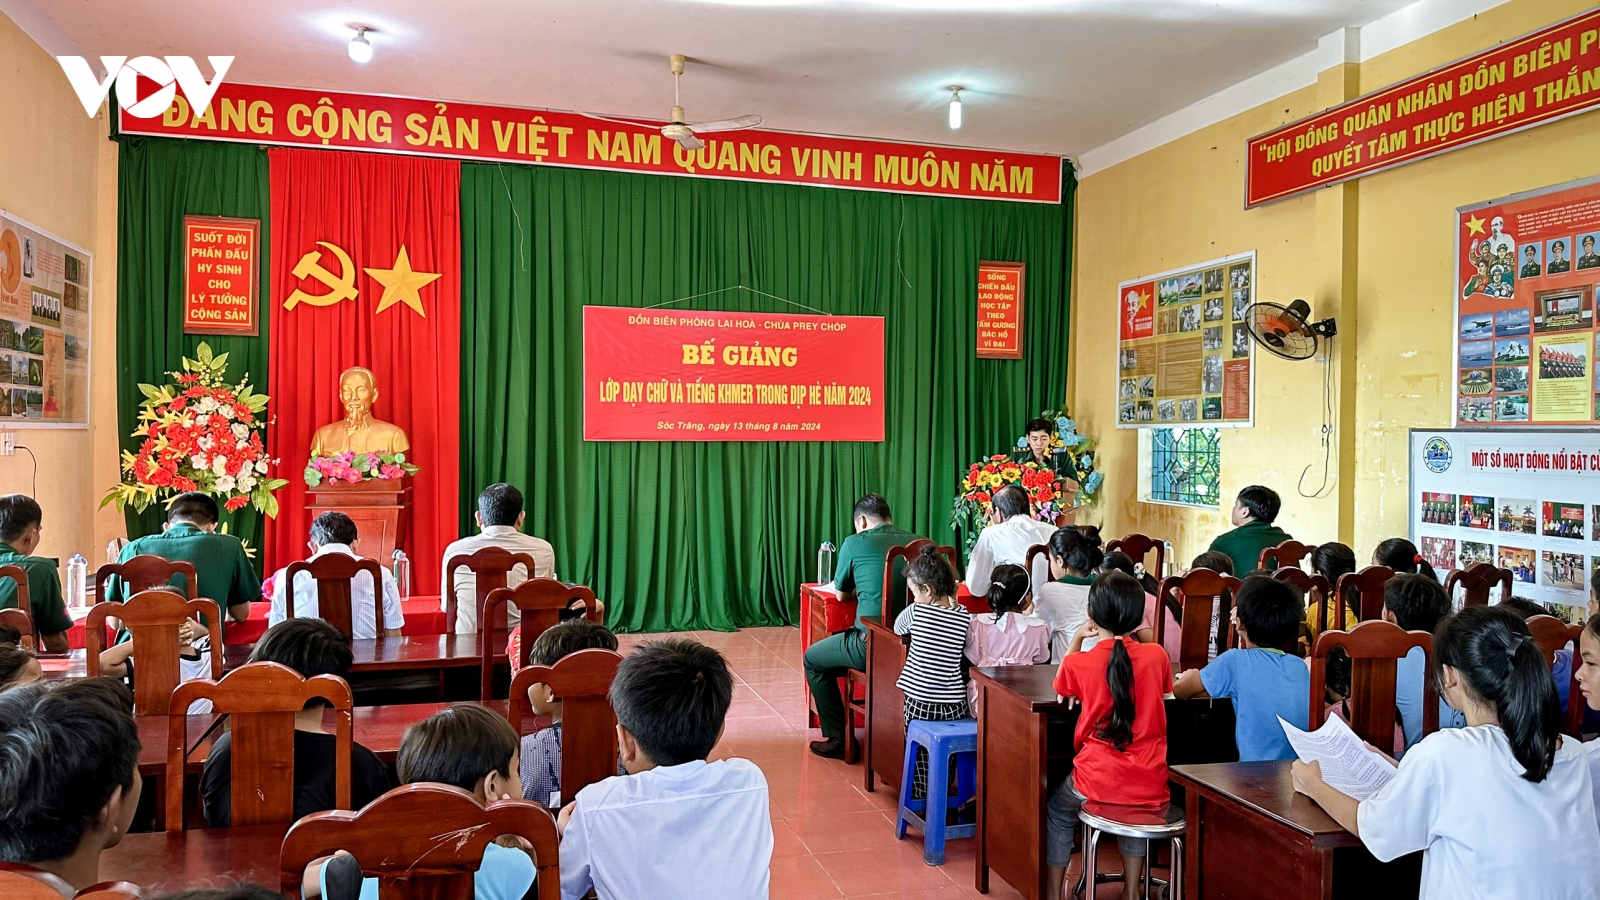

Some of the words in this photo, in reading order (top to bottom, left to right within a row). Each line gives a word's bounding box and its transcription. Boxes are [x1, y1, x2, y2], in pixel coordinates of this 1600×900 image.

[1295, 124, 1338, 153] ĐỒNG
[1343, 103, 1391, 136] QUÂN
[1397, 83, 1452, 118] NHÂN
[1459, 61, 1505, 96] ĐỒN
[1514, 41, 1571, 78] BIÊN
[1312, 141, 1362, 177] QUYẾT
[1368, 130, 1406, 158] TÂM
[1413, 112, 1464, 141] THỰC
[1472, 93, 1525, 124] HIỆN
[287, 97, 392, 144] CỘNG
[404, 103, 478, 150] SẢN
[492, 116, 573, 162] VIỆT
[588, 130, 660, 164] NAM
[673, 139, 780, 175] QUANG
[791, 147, 862, 181] VINH
[874, 151, 960, 189] MUÔN
[970, 159, 1034, 194] NĂM
[194, 231, 223, 243] SUỐT
[227, 233, 246, 244] ĐỜI
[192, 246, 222, 258] PHẤN
[226, 247, 248, 260] ĐẤU
[198, 264, 212, 273] HY
[216, 265, 242, 274] SINH
[987, 272, 1006, 280] SỐNG
[208, 279, 231, 289] CHO
[192, 292, 205, 303] LÝ
[210, 292, 246, 305] TƯỞNG
[997, 302, 1011, 310] TẬP
[191, 307, 221, 320] CỘNG
[225, 308, 246, 320] SẢN
[654, 316, 676, 325] BIÊN
[680, 317, 714, 327] PHÒNG
[736, 319, 755, 328] HOÀ
[764, 320, 790, 330] CHÙA
[682, 338, 715, 364] BẾ
[723, 341, 797, 367] GIẢNG
[600, 377, 620, 402] LỚP
[623, 382, 643, 407] DẠY
[647, 378, 668, 403] CHỮ
[670, 379, 683, 403] VÀ
[686, 377, 715, 403] TIẾNG
[718, 384, 753, 404] KHMER
[756, 384, 788, 404] TRONG
[791, 385, 806, 409] DỊP
[809, 381, 821, 405] HÈ
[824, 382, 846, 405] NĂM
[848, 386, 871, 405] 2024
[657, 421, 674, 430] Sóc
[678, 422, 705, 431] Trăng,
[708, 422, 730, 431] ngày
[746, 422, 770, 432] tháng
[1472, 449, 1488, 470] MỘT
[1491, 447, 1500, 467] SỐ
[1504, 453, 1524, 472] HOẠT
[1526, 450, 1550, 472] ĐỘNG
[1552, 448, 1567, 470] NỔI
[1570, 451, 1587, 474] BẬT
